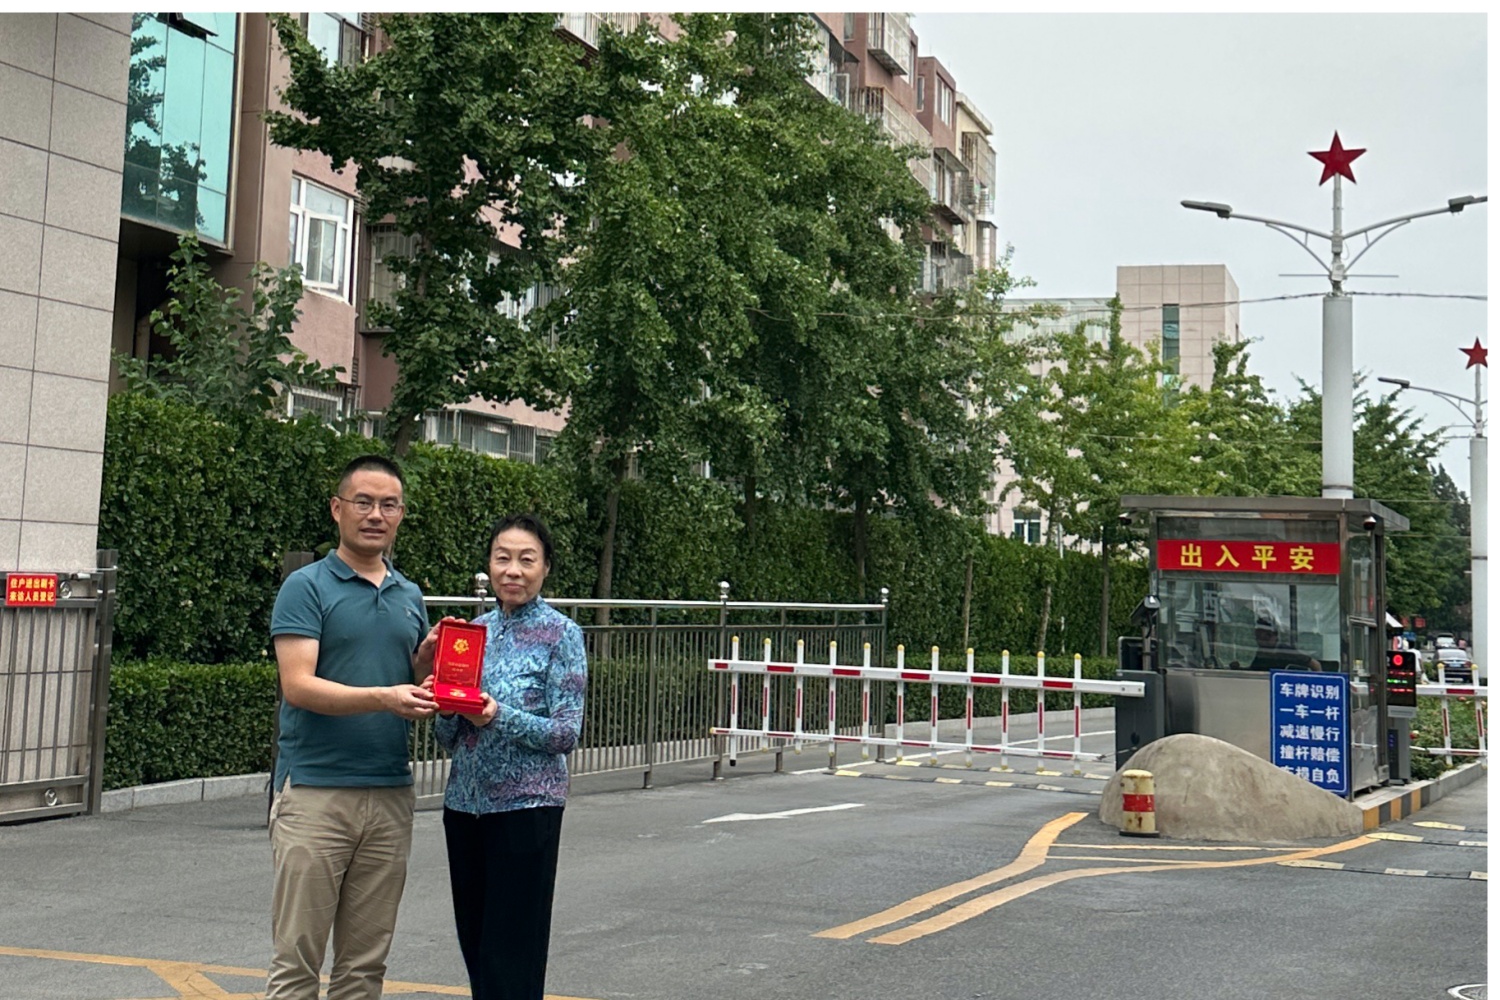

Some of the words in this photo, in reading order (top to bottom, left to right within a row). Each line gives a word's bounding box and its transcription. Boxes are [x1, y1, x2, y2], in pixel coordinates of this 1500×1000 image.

[1180, 543, 1316, 572] 出入平安
[1279, 682, 1340, 700] 车牌识别
[1279, 703, 1340, 721] 一车一杆
[1279, 723, 1340, 742] 减速慢行
[1279, 744, 1340, 763] 撞杆赔偿
